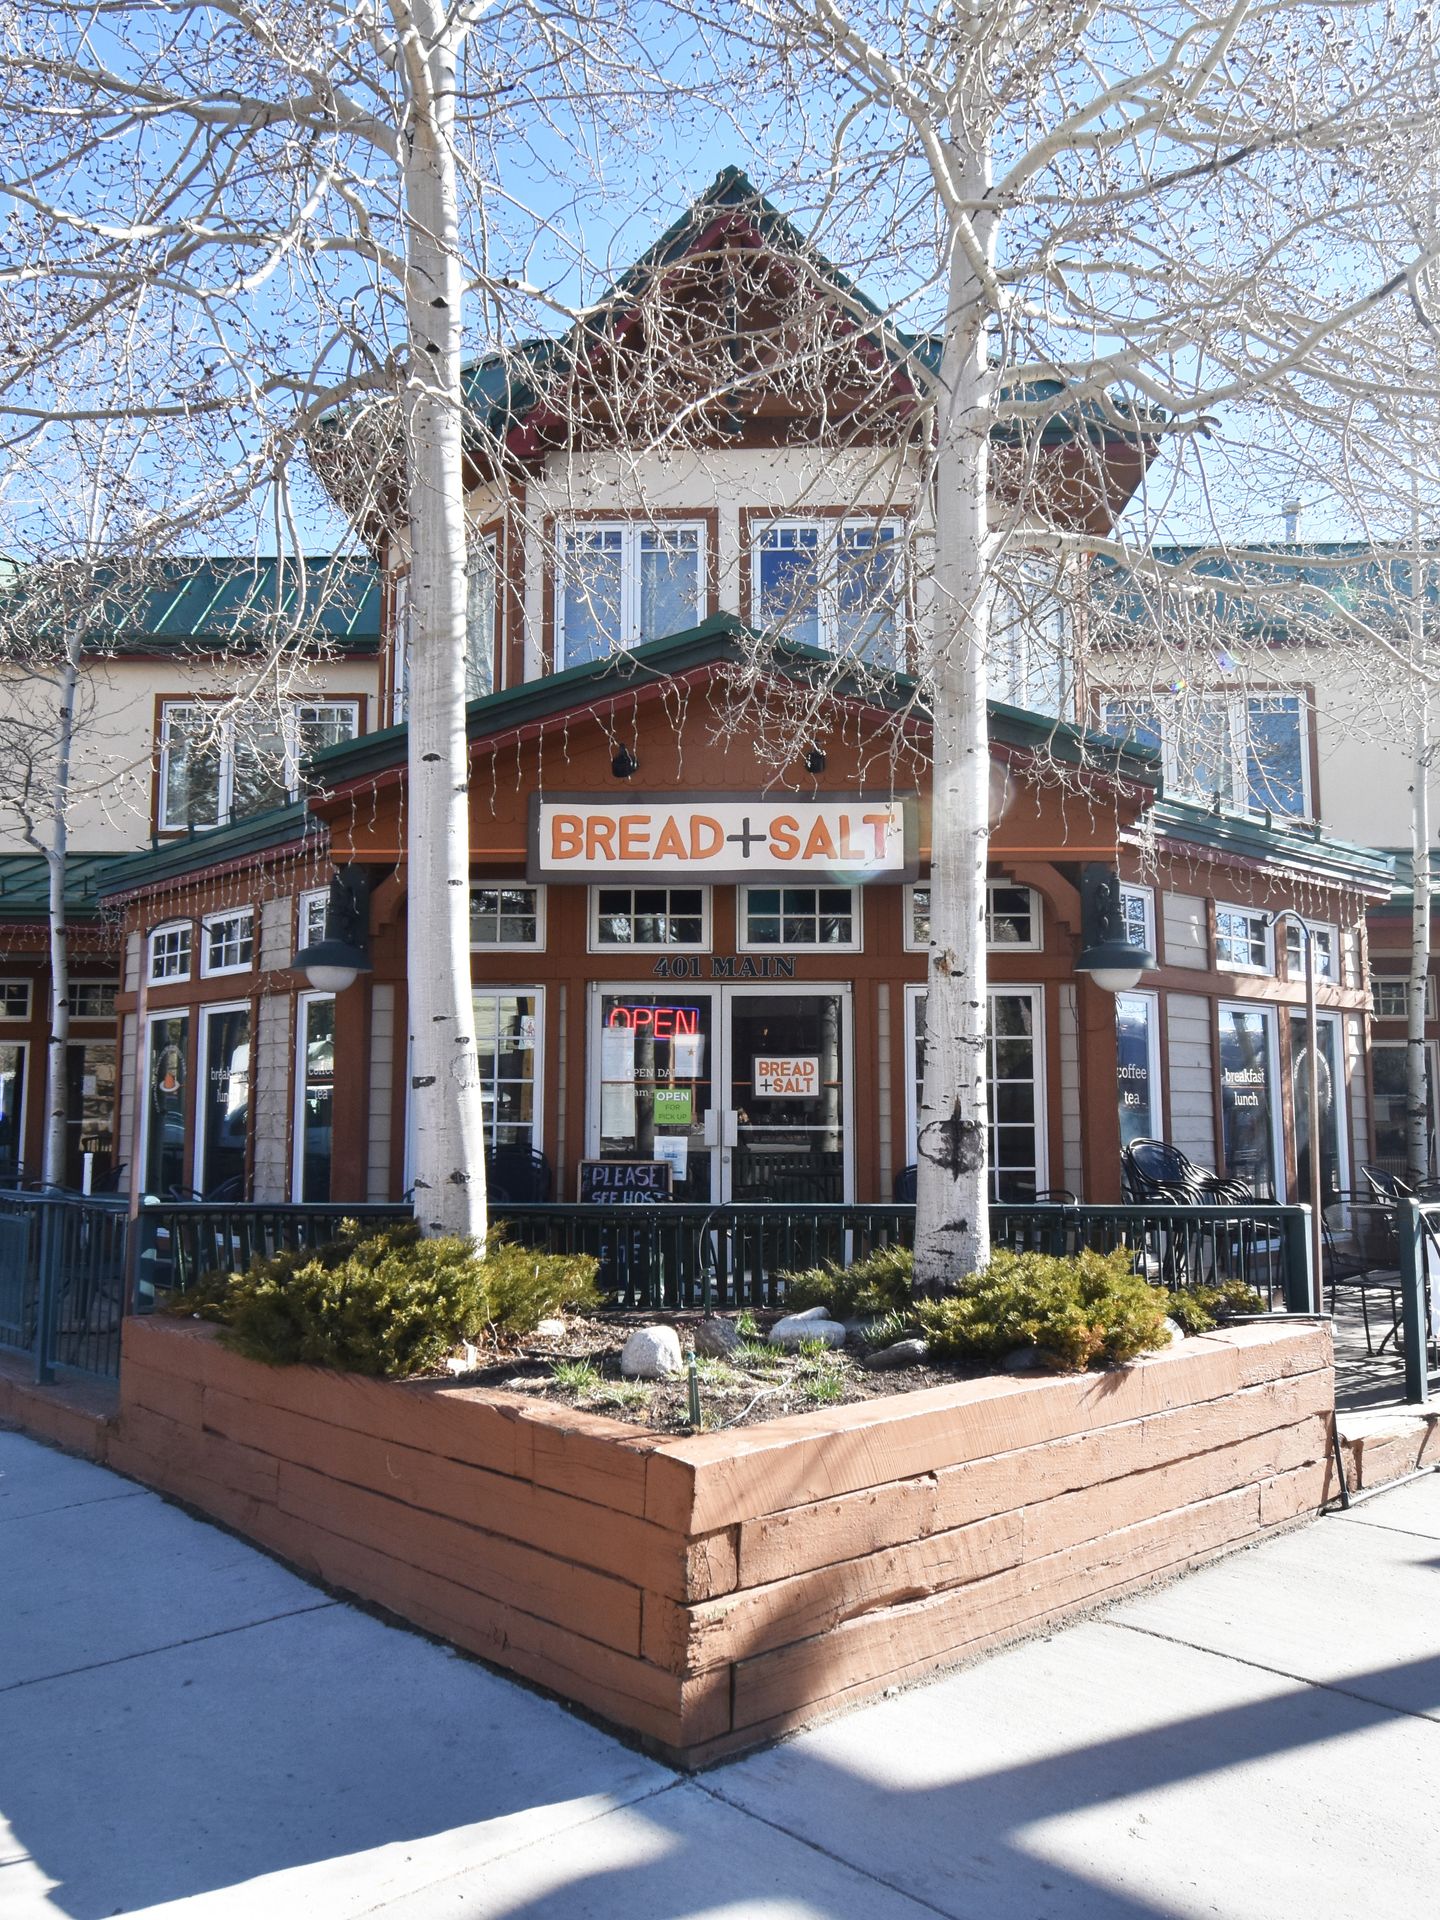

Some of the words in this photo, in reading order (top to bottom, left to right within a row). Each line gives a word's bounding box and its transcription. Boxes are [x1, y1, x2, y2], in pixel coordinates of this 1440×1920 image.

[653, 956, 702, 978] 401
[711, 956, 796, 978] MAIN
[610, 1007, 696, 1038] OPEN
[758, 1061, 815, 1076] BREAD
[1224, 1067, 1265, 1083] breakfast
[656, 1091, 689, 1101] OPEN
[1124, 1090, 1140, 1105] tea
[1234, 1091, 1259, 1106] lunch
[665, 1103, 681, 1111] FOR
[591, 1165, 659, 1188] PLEASE
